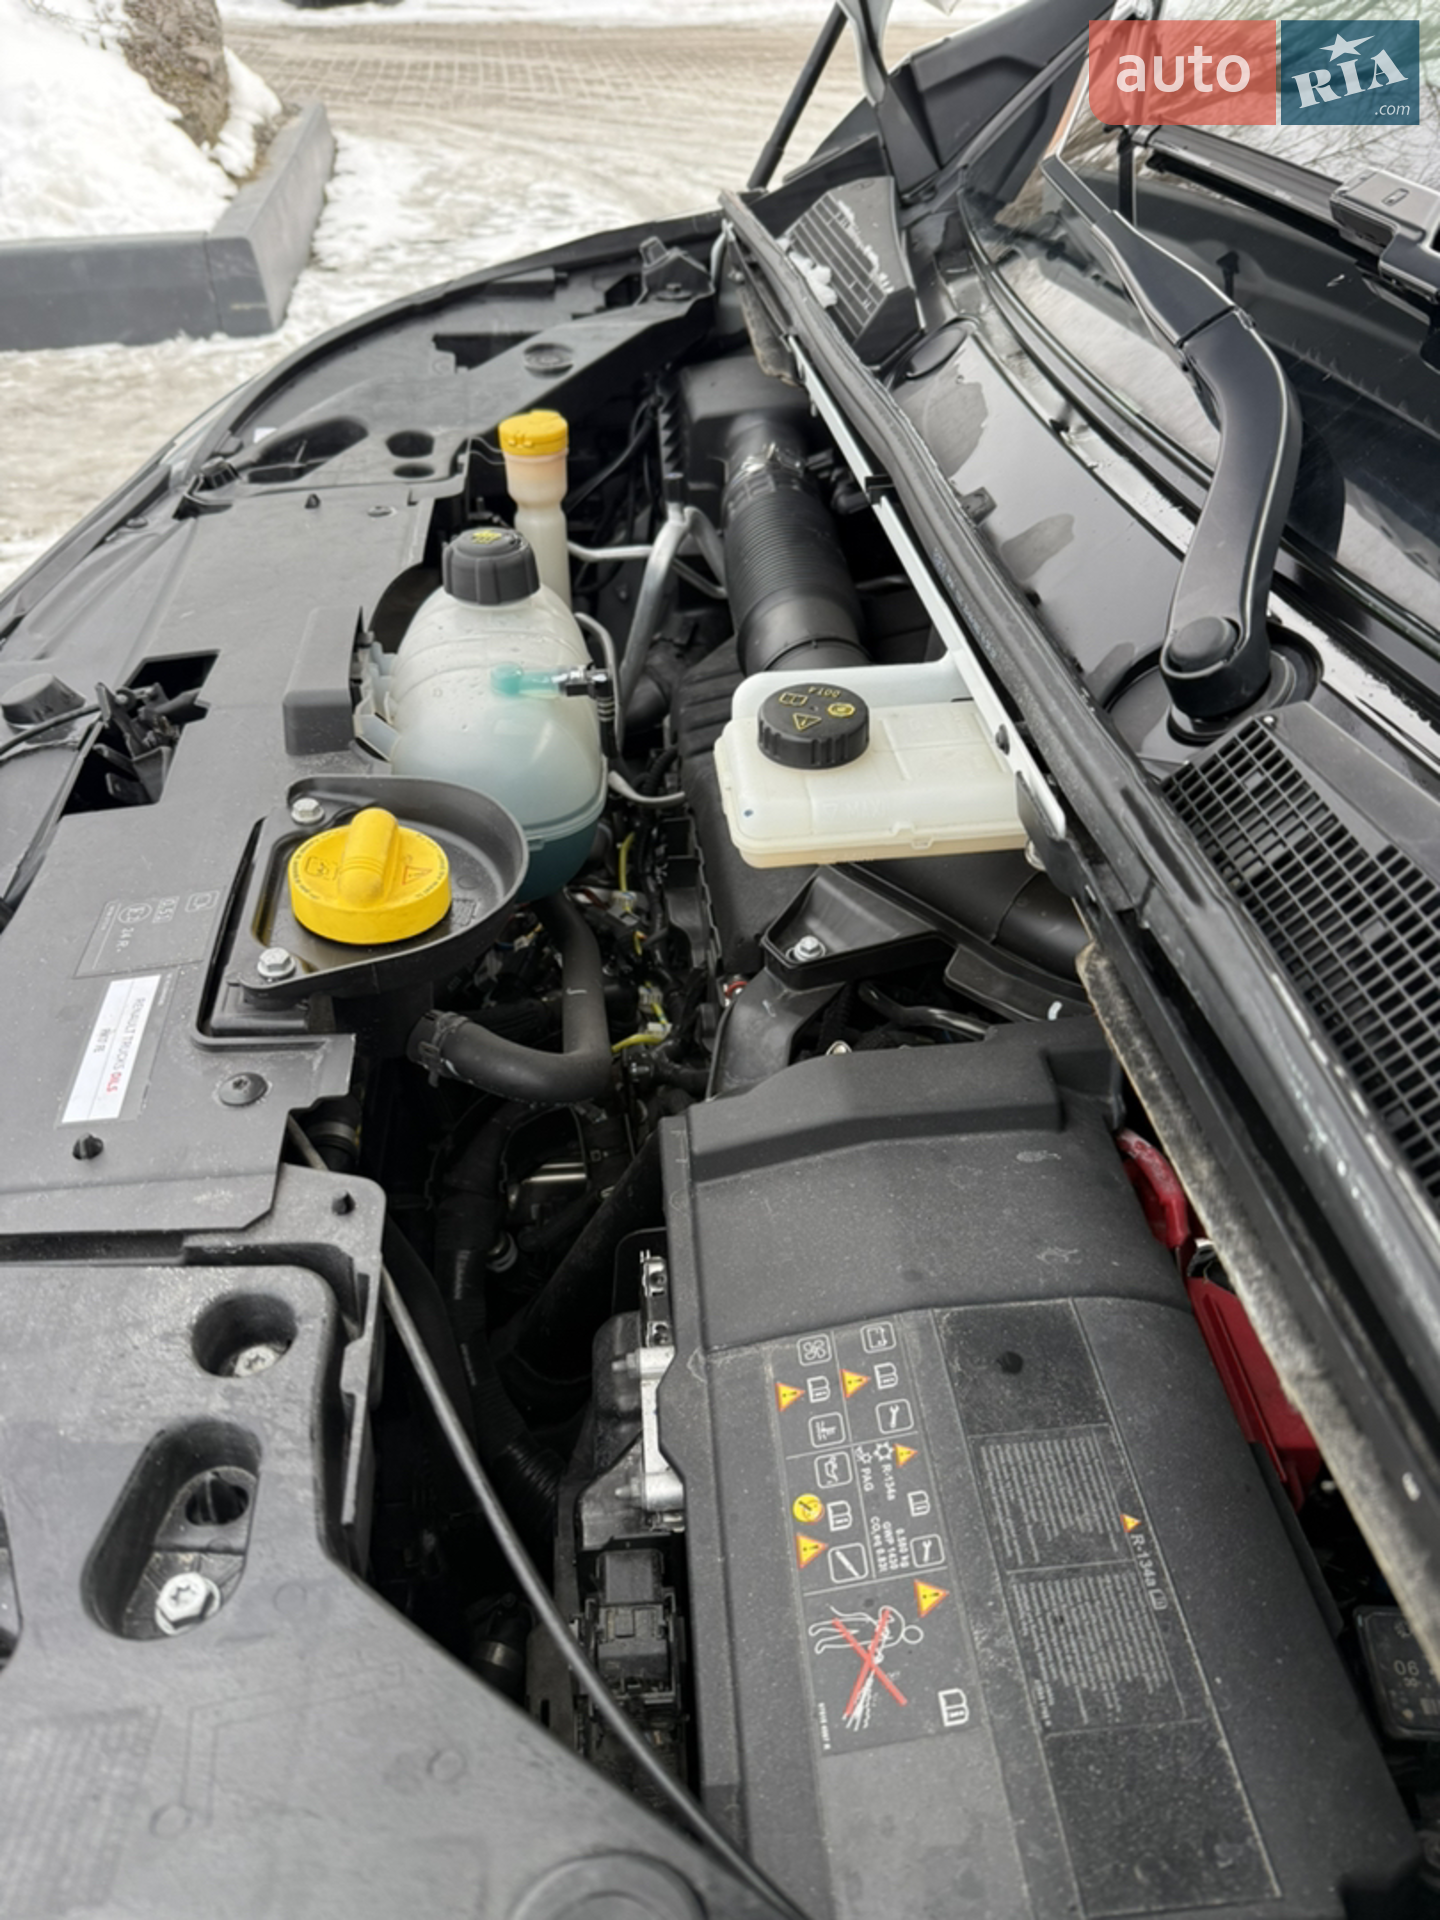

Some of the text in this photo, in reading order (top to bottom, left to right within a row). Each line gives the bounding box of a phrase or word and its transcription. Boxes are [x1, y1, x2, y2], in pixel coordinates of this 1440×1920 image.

[106, 997, 146, 1094] RENAULT TRUCKS OILS
[860, 1466, 875, 1493] PAG
[881, 1463, 896, 1501] R-134a
[1130, 1533, 1157, 1588] R-134a
